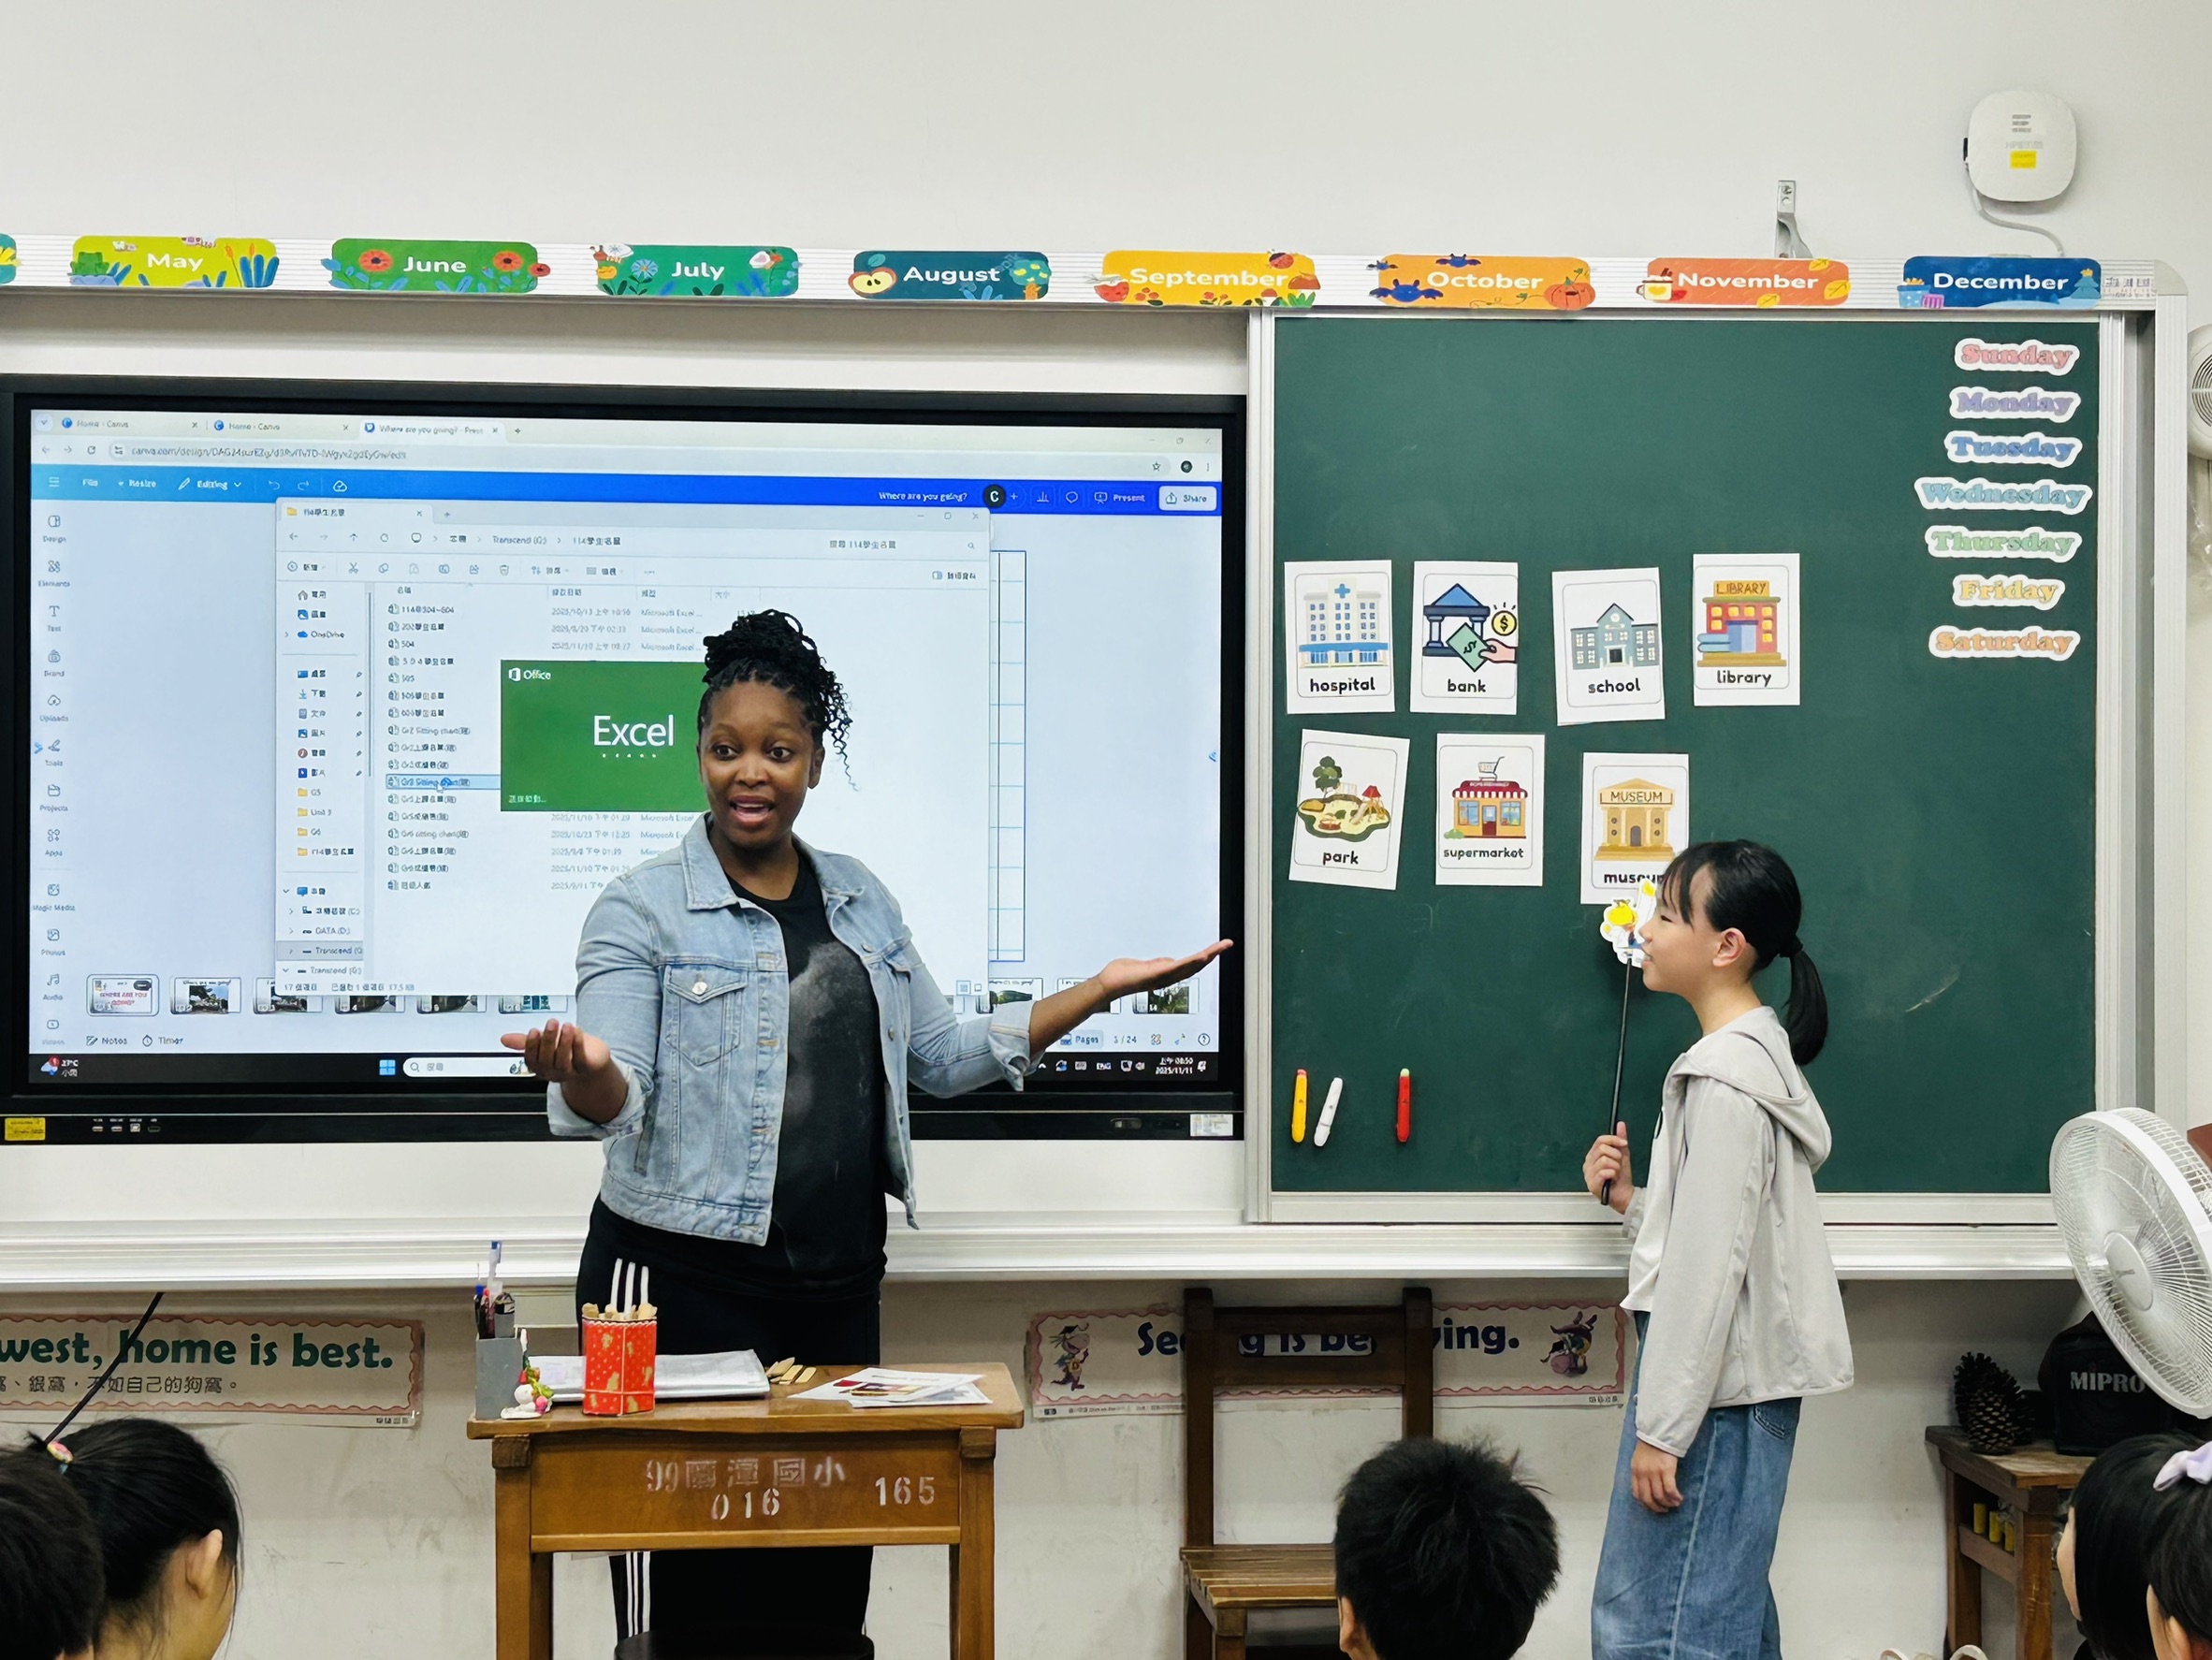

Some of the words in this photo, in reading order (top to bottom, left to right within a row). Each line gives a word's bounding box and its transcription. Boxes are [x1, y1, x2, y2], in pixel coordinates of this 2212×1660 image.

[147, 253, 204, 271] May
[402, 255, 467, 273] June
[671, 262, 725, 282] July
[903, 266, 1001, 284] August
[1129, 268, 1289, 290] September
[1426, 271, 1544, 290] October
[1678, 272, 1819, 290] November
[1933, 272, 2070, 290] December
[1961, 343, 2074, 370] Sunday
[1957, 392, 2074, 416] Monday
[1951, 436, 2075, 461] Tuesday
[878, 492, 907, 502] Where
[923, 493, 939, 503] you
[1183, 494, 1208, 503] Share
[1921, 483, 2087, 509] Wednesday
[1931, 531, 2075, 556] Thursday
[1716, 582, 1767, 596] LIBRARY
[1959, 579, 2059, 604] Friday
[1935, 631, 2074, 655] Saturday
[523, 669, 552, 680] Office
[1717, 670, 1772, 688] library
[1310, 677, 1375, 694] hospital
[1447, 678, 1486, 693] bank
[1588, 677, 1641, 694] school
[593, 713, 675, 747] Excel
[1610, 792, 1663, 803] MUSEUM
[1322, 850, 1359, 866] park
[1443, 848, 1524, 860] supermarket
[101, 1037, 128, 1045] Notes
[1126, 1035, 1138, 1044] 24
[120, 1329, 237, 1365] home
[250, 1333, 278, 1366] is
[292, 1332, 393, 1369] best.
[2070, 1371, 2146, 1393] MIPRO
[875, 1477, 936, 1506] 165
[711, 1488, 780, 1521] 016
